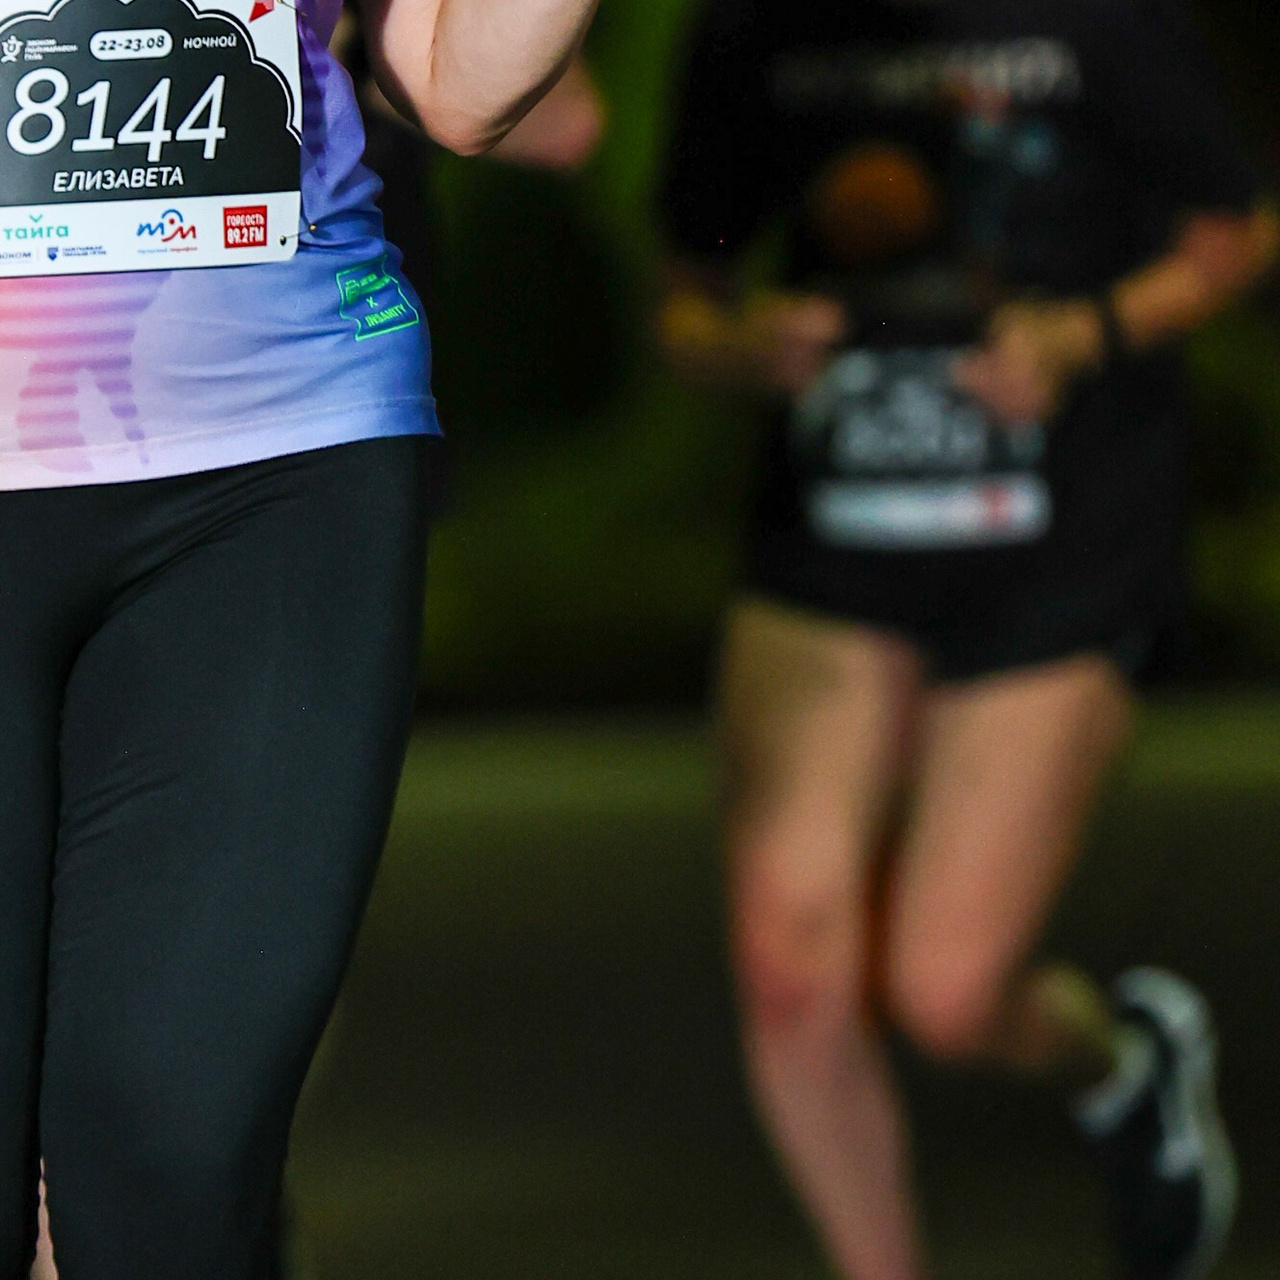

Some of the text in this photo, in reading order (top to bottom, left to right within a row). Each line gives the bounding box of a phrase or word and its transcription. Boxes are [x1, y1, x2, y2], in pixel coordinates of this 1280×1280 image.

[98, 35, 166, 52] 22-23.08
[6, 67, 227, 162] 8144
[52, 166, 185, 193] ЕЛИЗАВЕТА
[249, 226, 265, 242] FM
